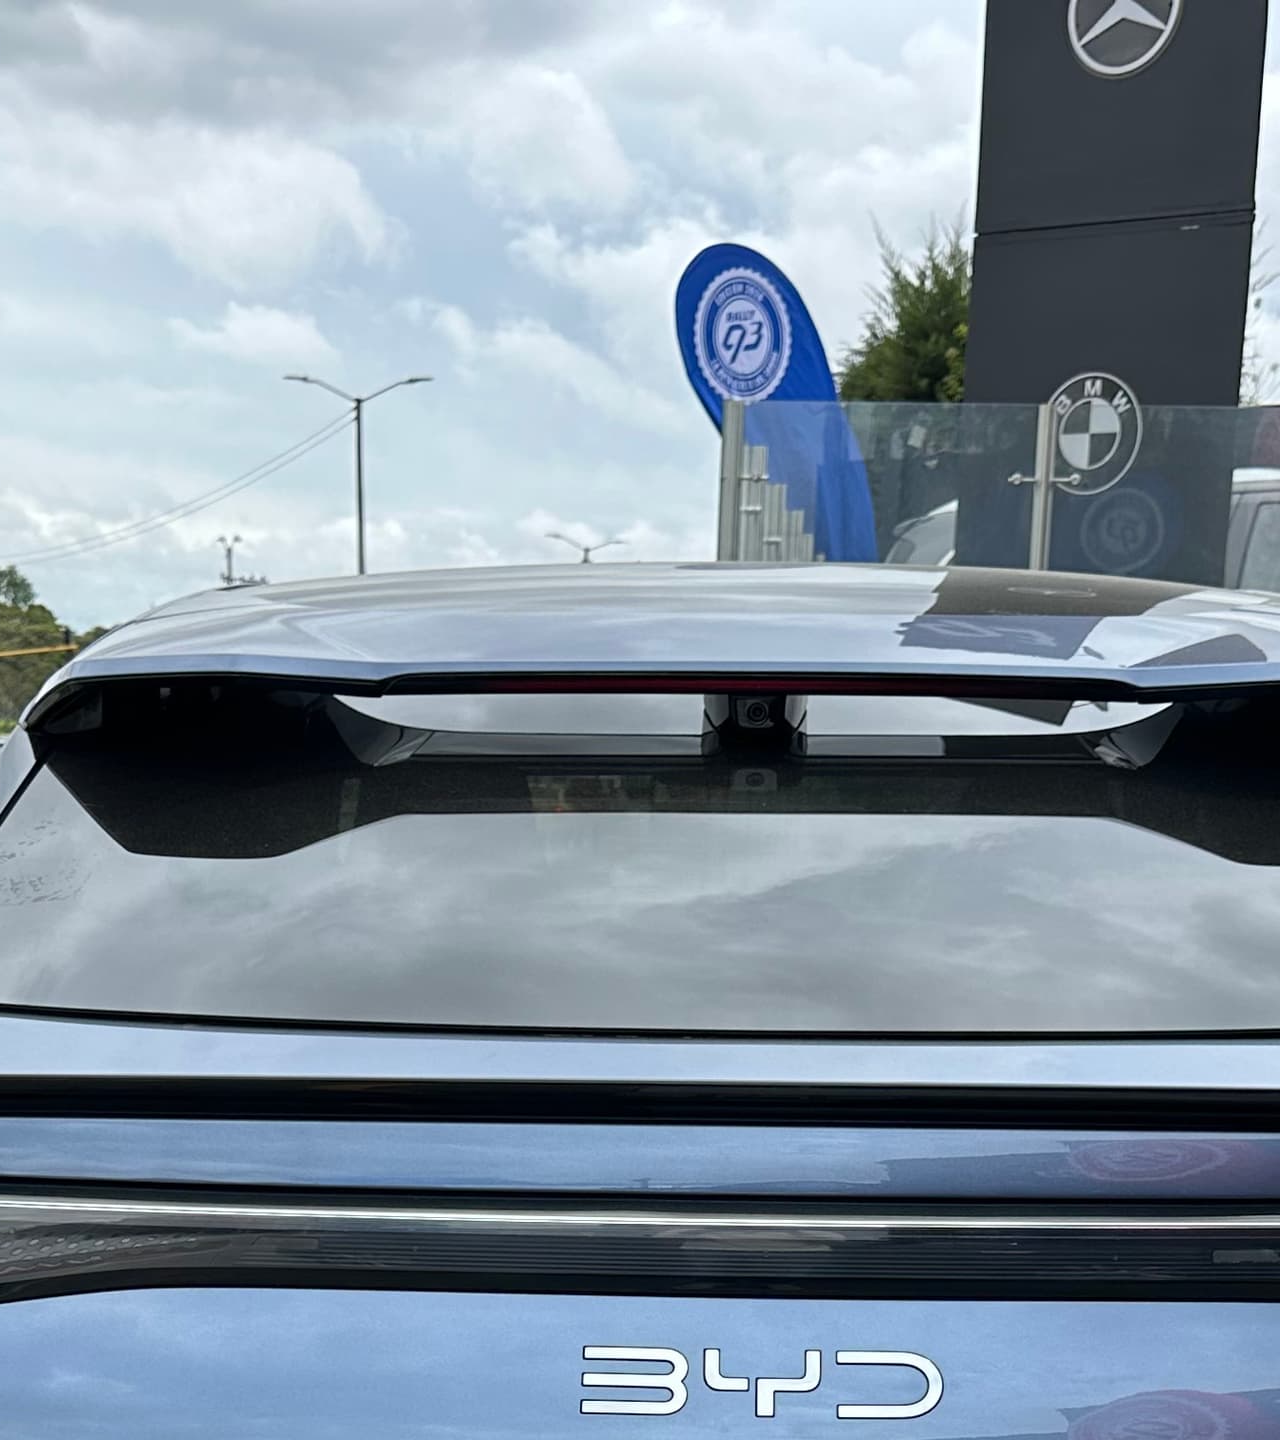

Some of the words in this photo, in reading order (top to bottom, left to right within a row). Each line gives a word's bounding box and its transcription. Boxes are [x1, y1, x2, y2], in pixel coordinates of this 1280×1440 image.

[722, 321, 763, 365] 93
[1054, 379, 1131, 416] BMW
[579, 1345, 945, 1419] BYD
